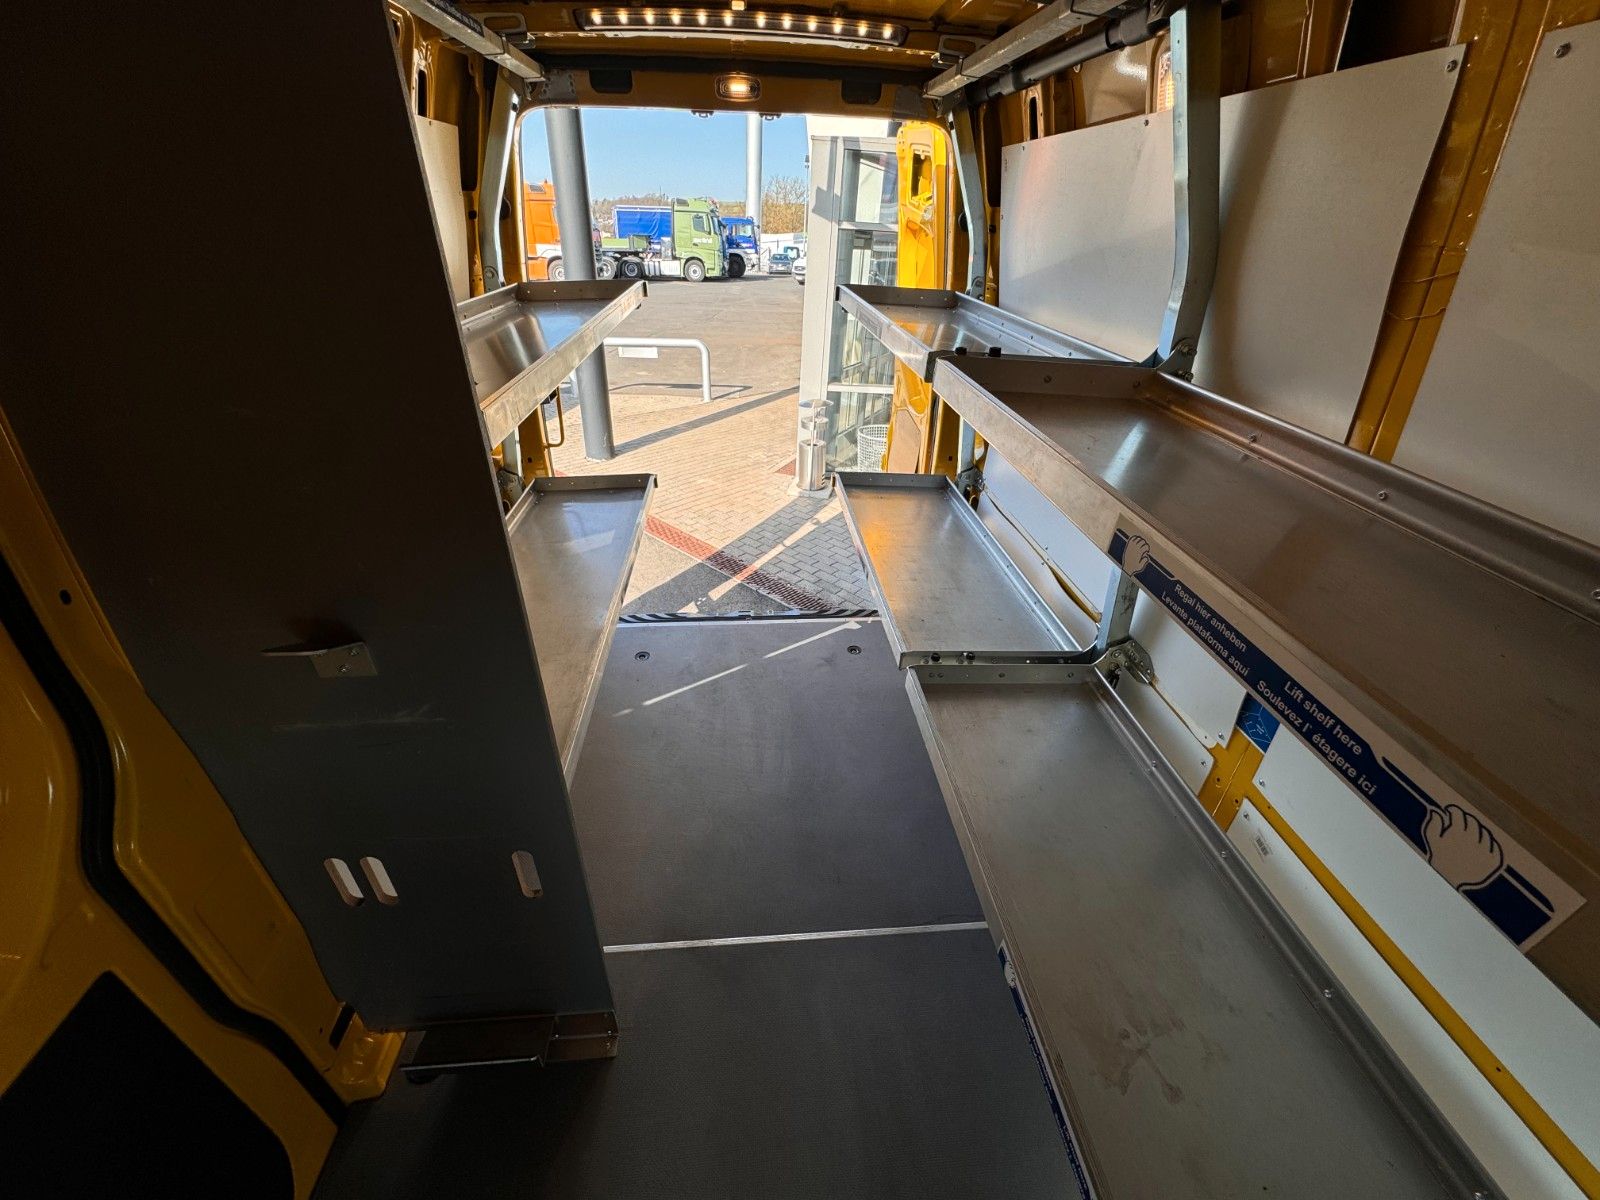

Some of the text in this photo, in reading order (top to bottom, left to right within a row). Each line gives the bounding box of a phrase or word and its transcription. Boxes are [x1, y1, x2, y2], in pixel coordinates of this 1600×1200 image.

[1161, 590, 1188, 620] Levante
[1187, 618, 1228, 658] plataforma
[1174, 584, 1247, 652] Regal hier anheben
[1257, 680, 1303, 727] Soulevez
[1357, 774, 1377, 795] ici
[1284, 681, 1362, 755] Lift shelf here
